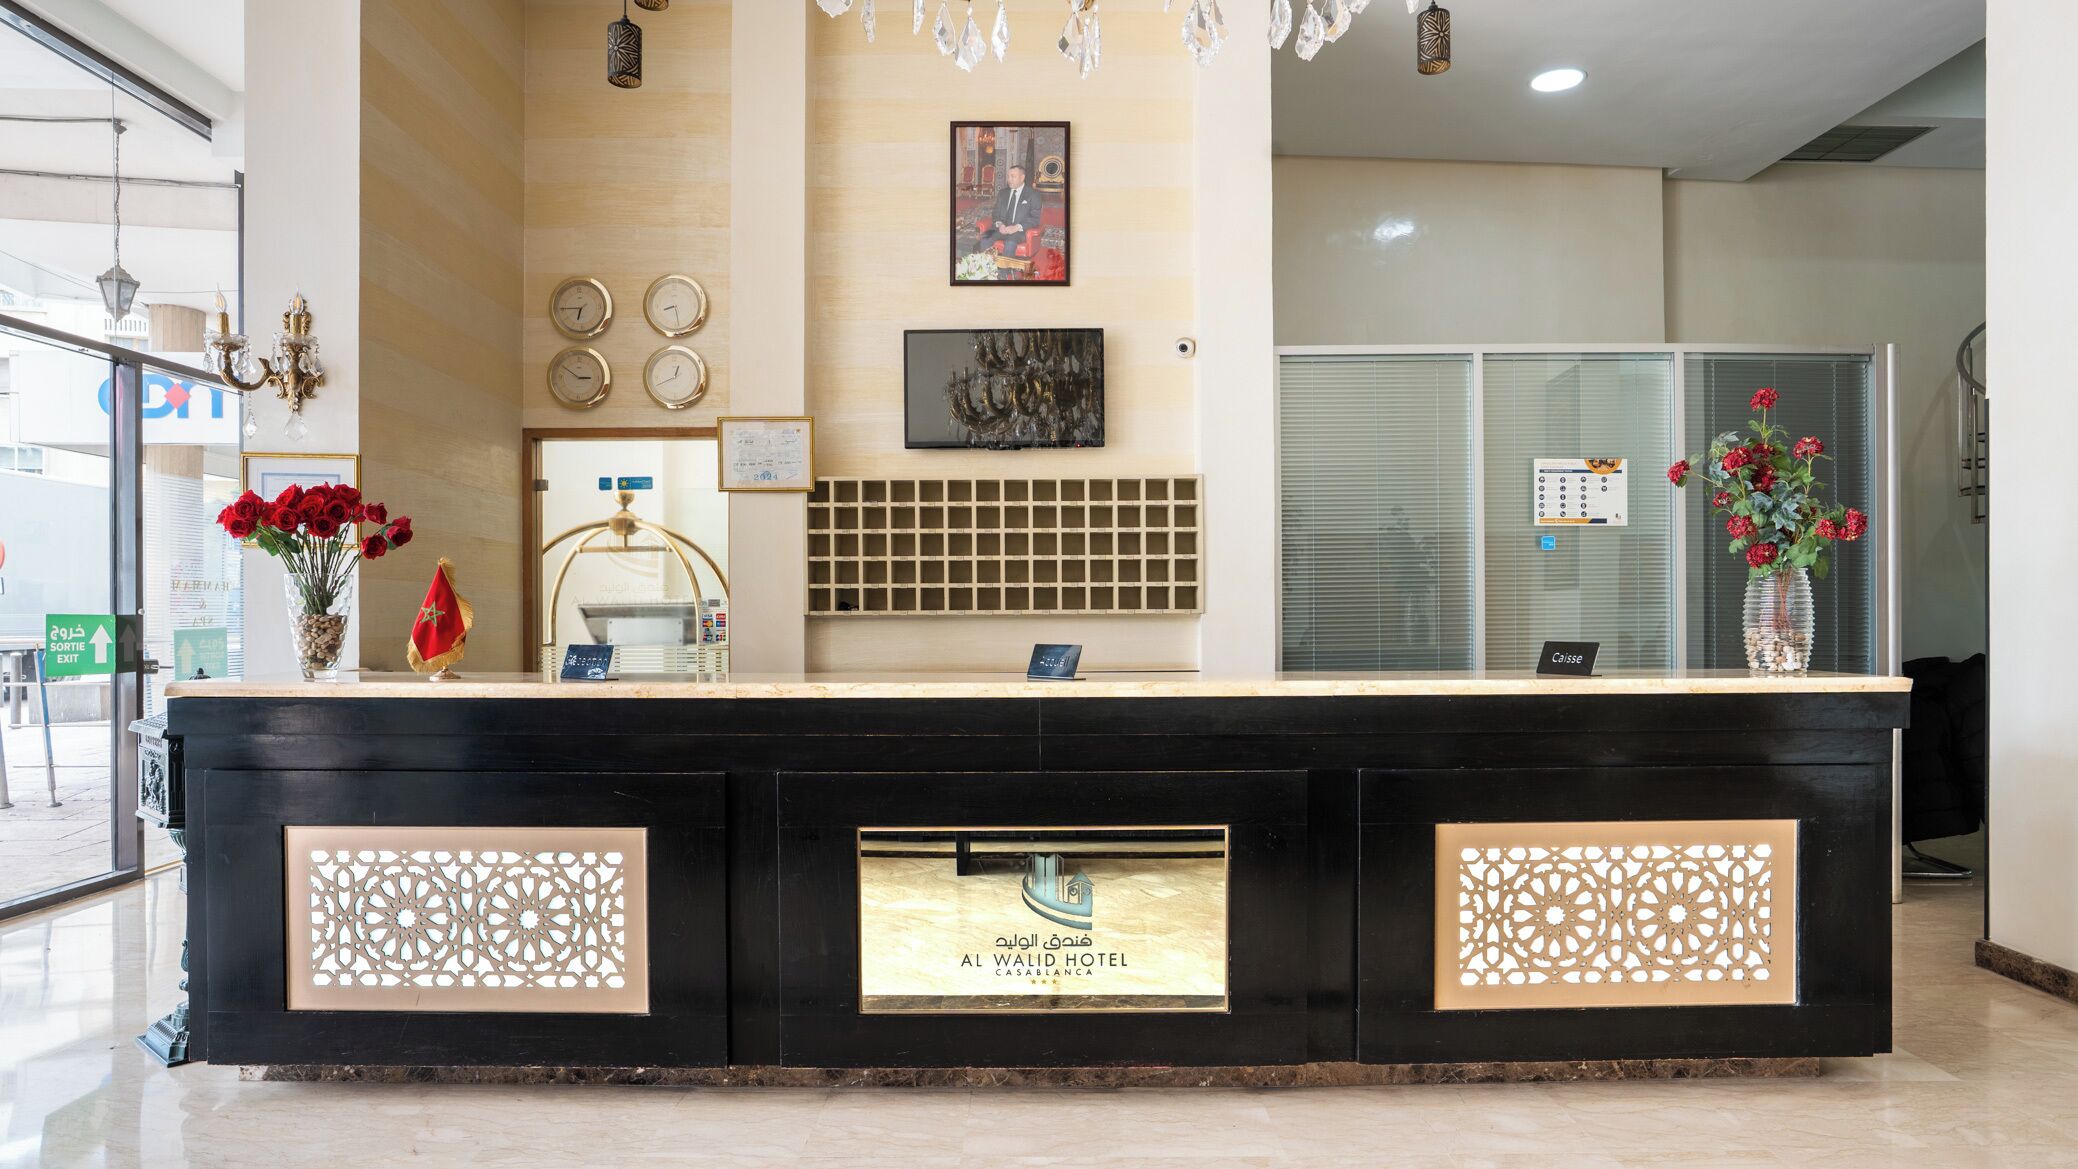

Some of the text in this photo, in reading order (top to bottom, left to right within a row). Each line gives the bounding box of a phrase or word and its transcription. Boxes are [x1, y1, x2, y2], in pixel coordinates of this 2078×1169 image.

[50, 624, 85, 640] خروج
[50, 642, 85, 651] SORTIE
[57, 654, 79, 663] EXIT
[1552, 652, 1583, 664] Caisse
[995, 934, 1092, 950] فندق الوليد
[961, 953, 1128, 967] AL WALID HOTEL
[995, 968, 1093, 976] CASABLANCA
